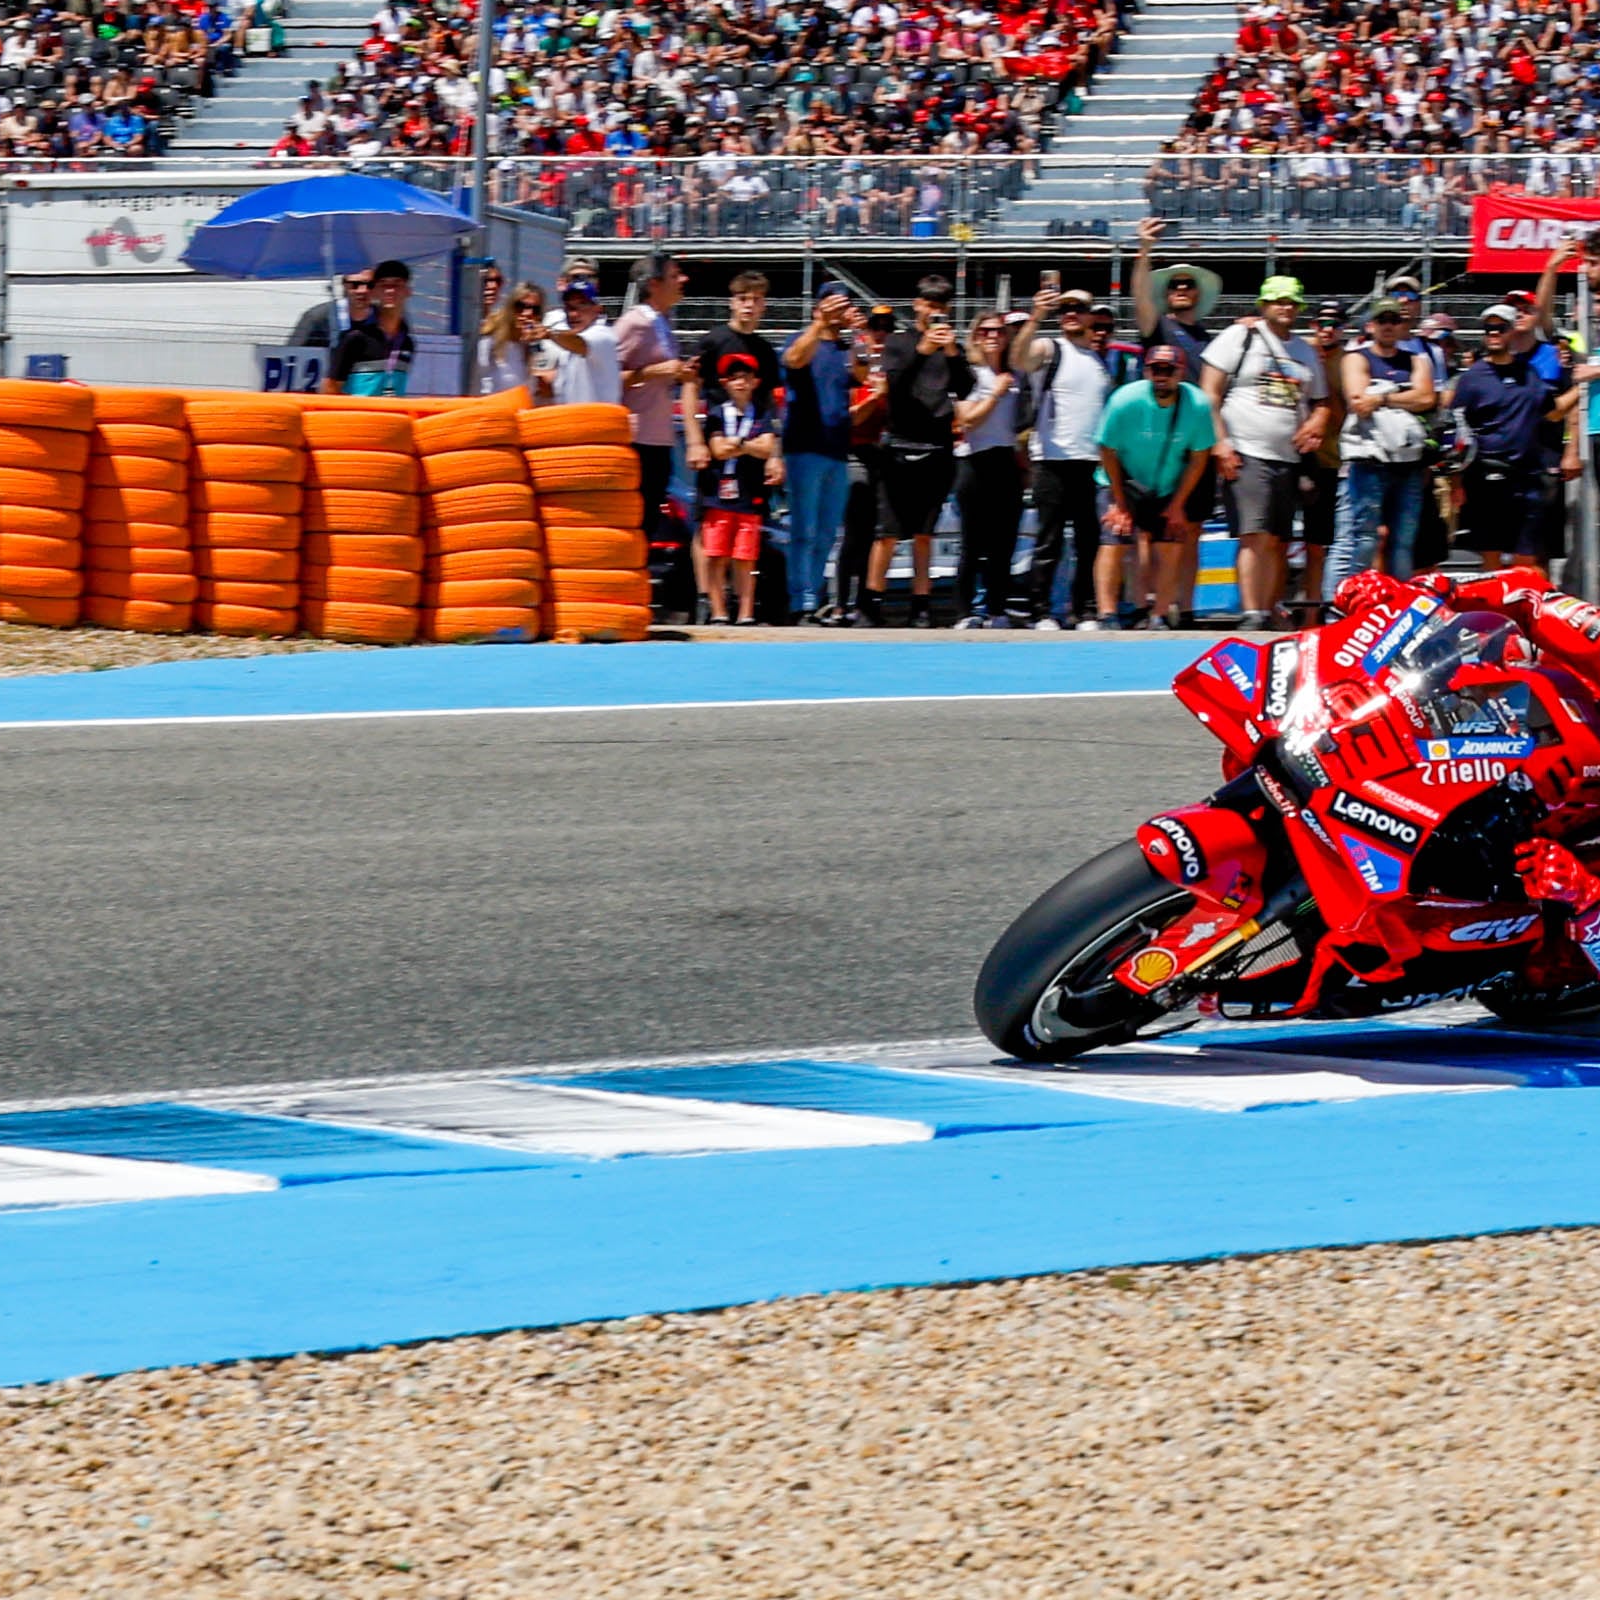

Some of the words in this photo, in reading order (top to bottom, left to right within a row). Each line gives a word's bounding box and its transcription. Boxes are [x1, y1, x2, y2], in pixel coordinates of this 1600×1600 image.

[1226, 664, 1254, 691] TIM
[1452, 720, 1499, 734] WRS
[1458, 740, 1527, 755] ADVANCE
[1334, 791, 1418, 843] Lenovo
[1151, 817, 1199, 878] Lenovo
[1359, 860, 1383, 891] TIM
[1450, 914, 1539, 941] GIVI
